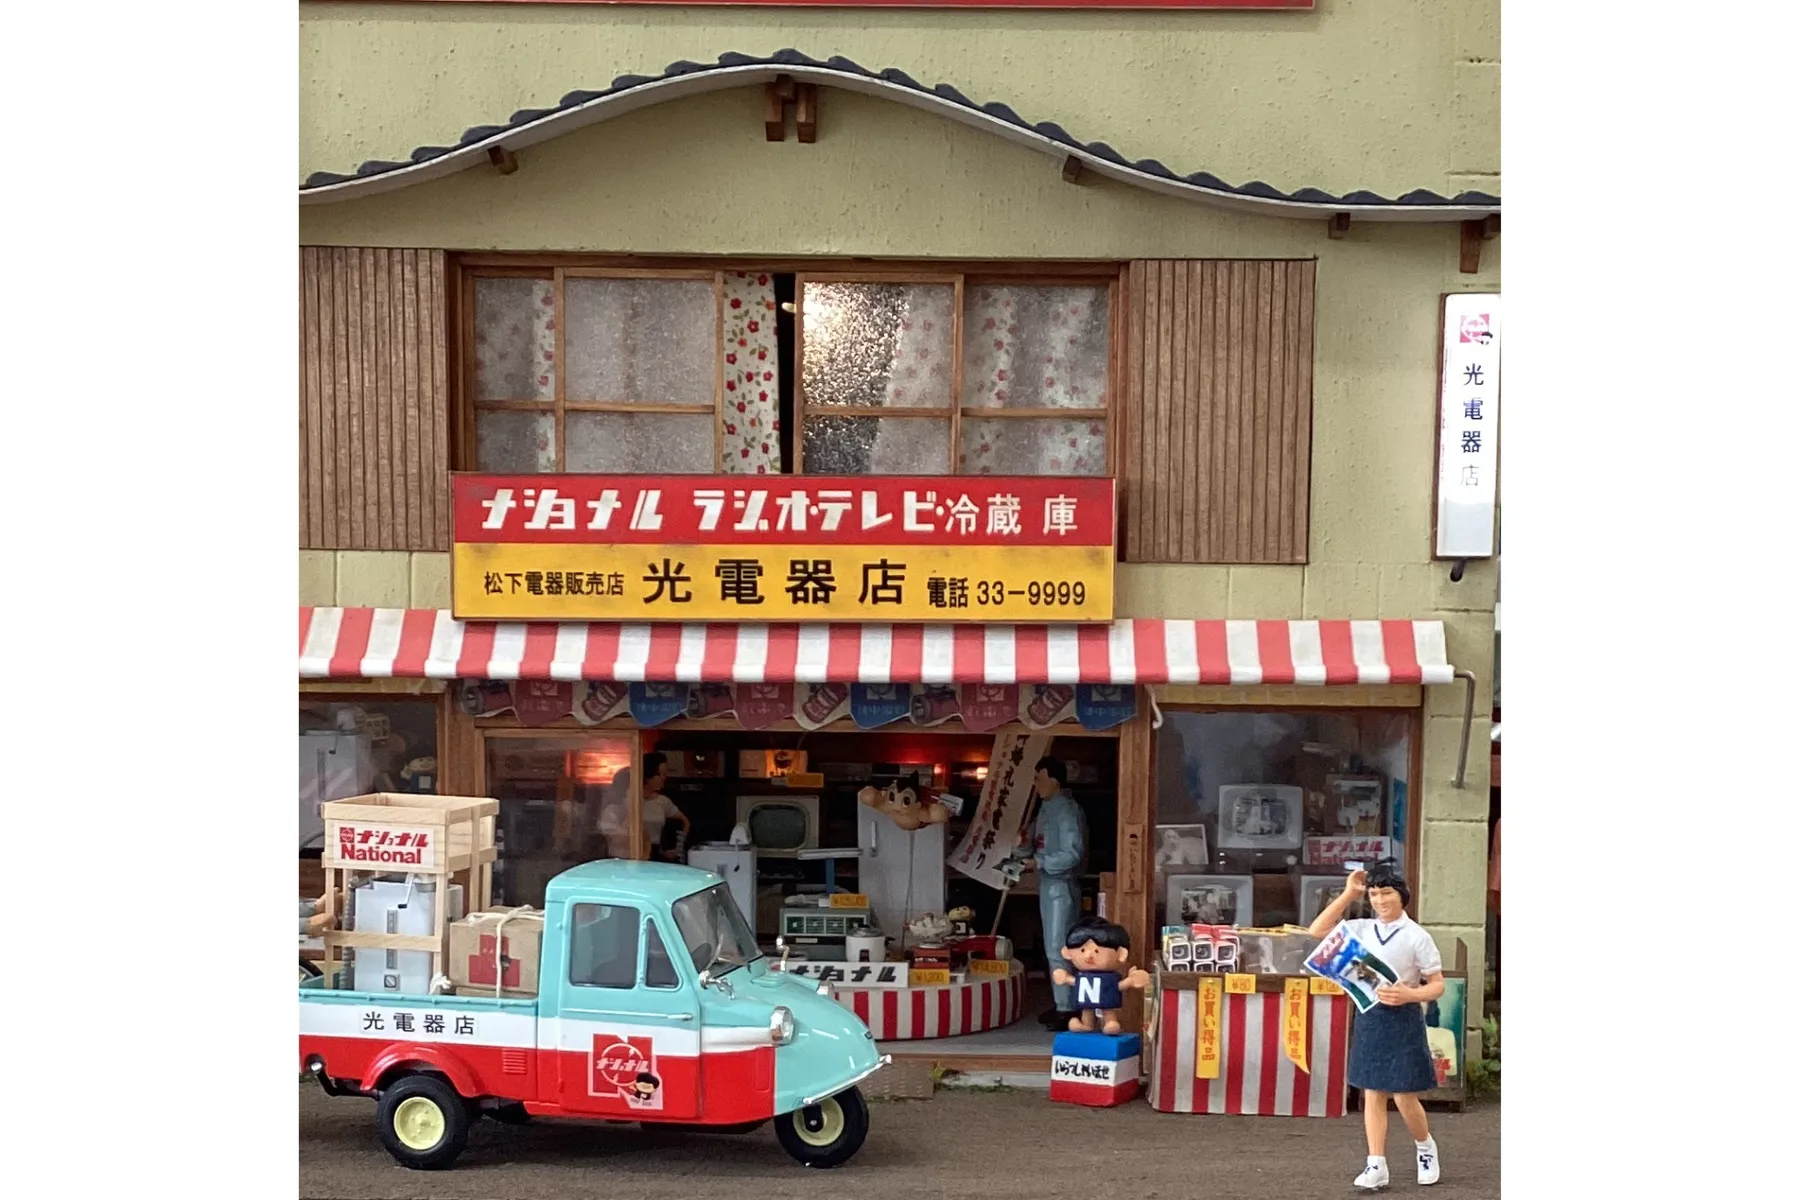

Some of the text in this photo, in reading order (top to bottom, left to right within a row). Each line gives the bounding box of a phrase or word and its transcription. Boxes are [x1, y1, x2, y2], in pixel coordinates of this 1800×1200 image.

[1460, 362, 1485, 487] 光電器店
[481, 488, 664, 531] ナショナル
[484, 557, 1086, 608] 松下電器販売店 光電器店 電話 33-9999
[356, 829, 429, 848] ナショナル
[340, 843, 422, 865] National
[789, 964, 898, 983] ナショナル
[1078, 976, 1102, 1004] N
[362, 1010, 476, 1036] 光電器店
[1201, 986, 1216, 1061] お買い得品
[1287, 986, 1302, 1061] お買い得品
[595, 1057, 650, 1073] ナショナル
